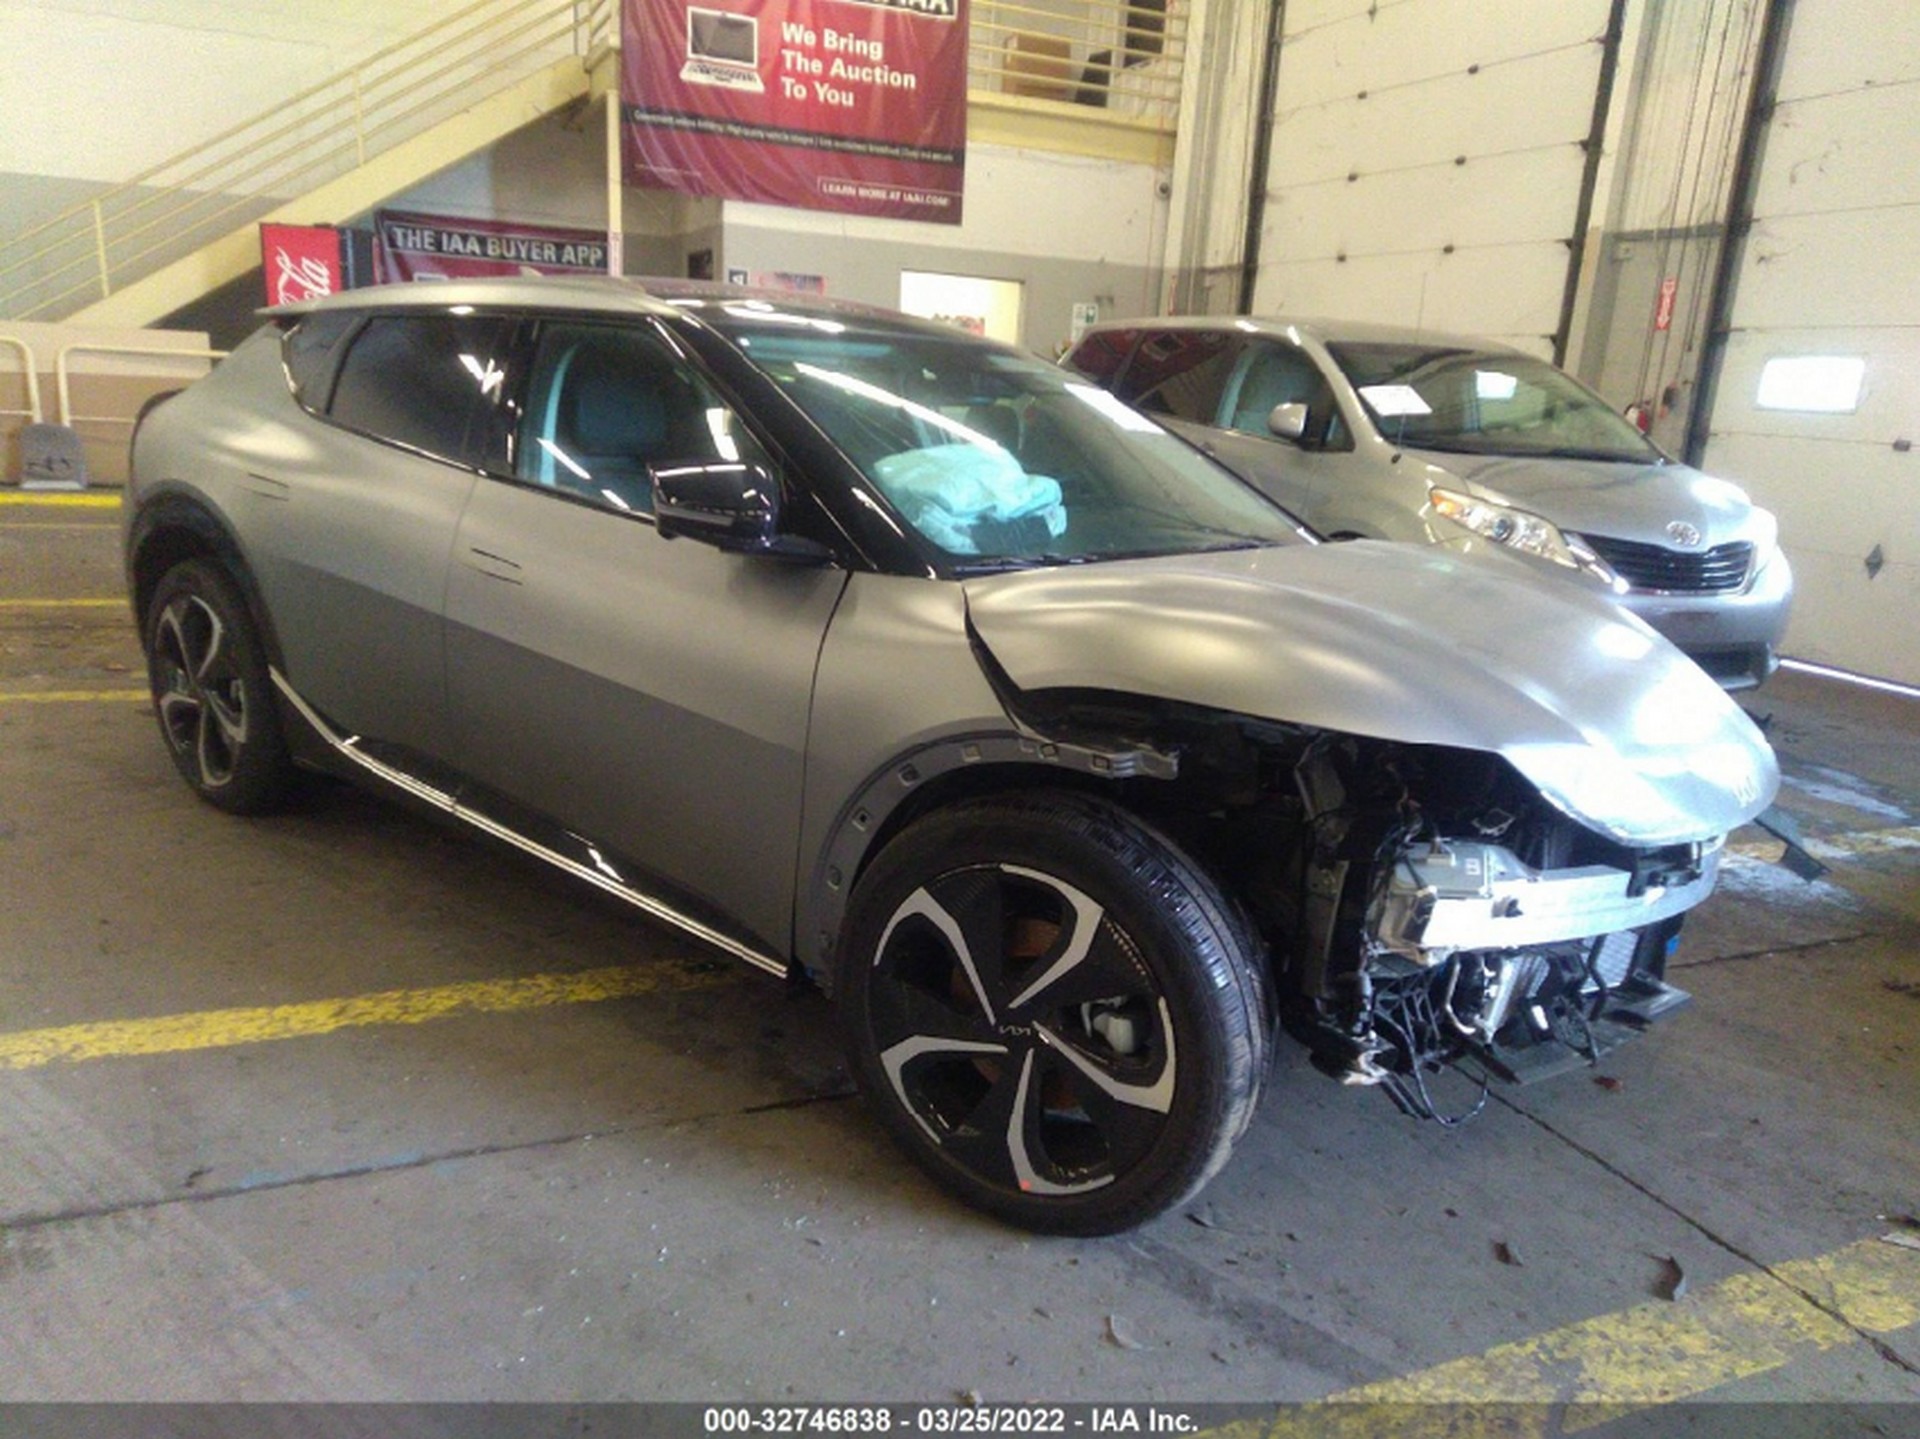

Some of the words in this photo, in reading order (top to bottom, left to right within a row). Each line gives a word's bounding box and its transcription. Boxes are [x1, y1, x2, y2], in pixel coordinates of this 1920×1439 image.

[781, 21, 816, 47] We
[823, 28, 883, 60] Bring
[781, 49, 823, 75] The
[829, 57, 916, 89] Auction
[780, 76, 807, 99] To
[813, 81, 854, 107] You
[822, 182, 856, 196] LEARN
[392, 227, 437, 251] THE
[441, 231, 482, 256] IAA
[487, 236, 557, 262] BUYER
[561, 243, 603, 266] APP
